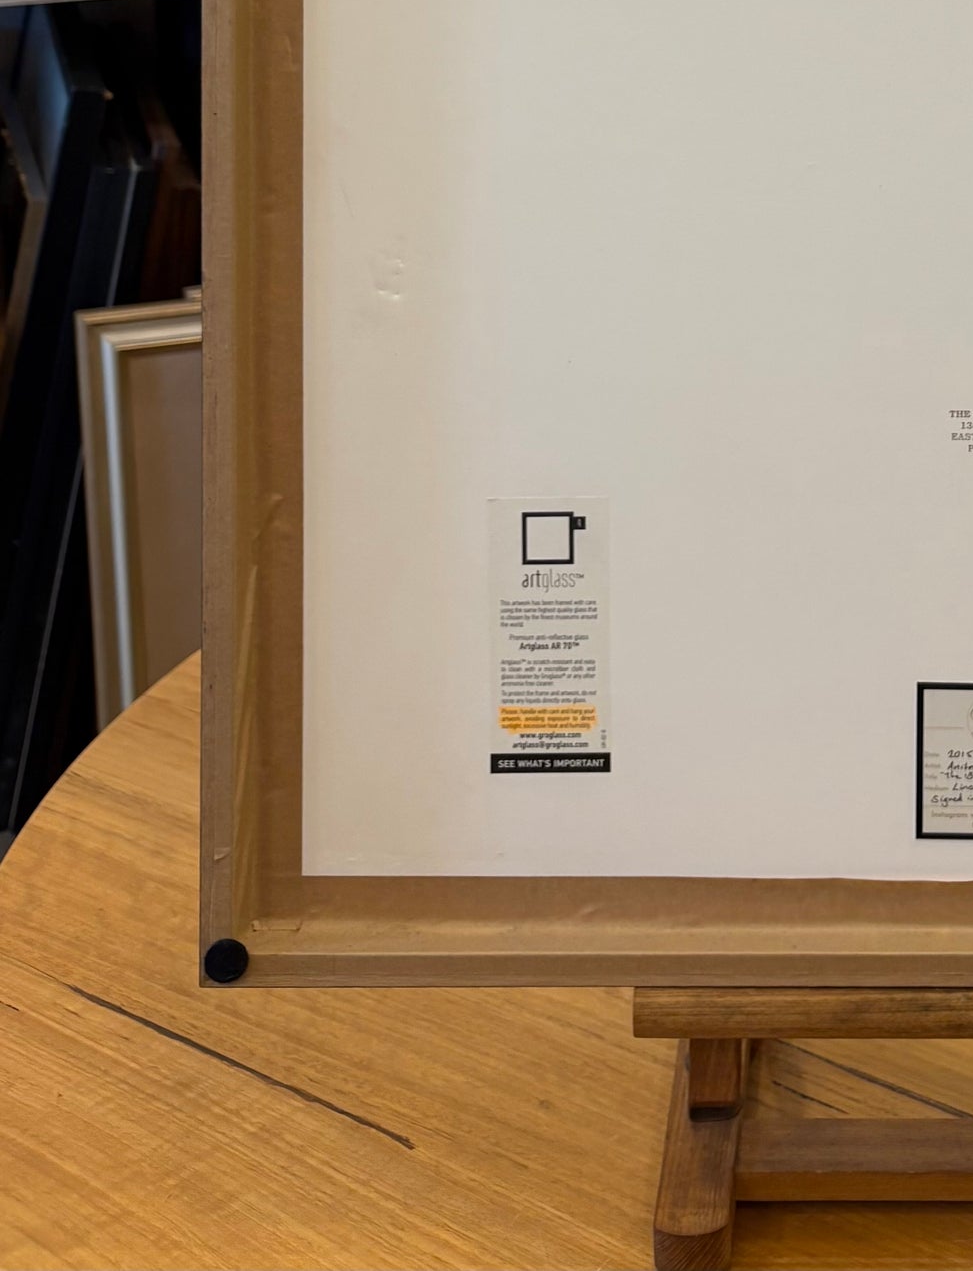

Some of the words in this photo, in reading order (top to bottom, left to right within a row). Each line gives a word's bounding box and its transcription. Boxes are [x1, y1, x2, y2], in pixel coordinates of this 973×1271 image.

[949, 410, 971, 418] THE
[519, 642, 549, 651] Artglass
[512, 741, 588, 749] artglass@groglass.com
[498, 759, 516, 768] SEE
[517, 759, 551, 768] WHAT'S
[553, 759, 605, 768] IMPORTANT
